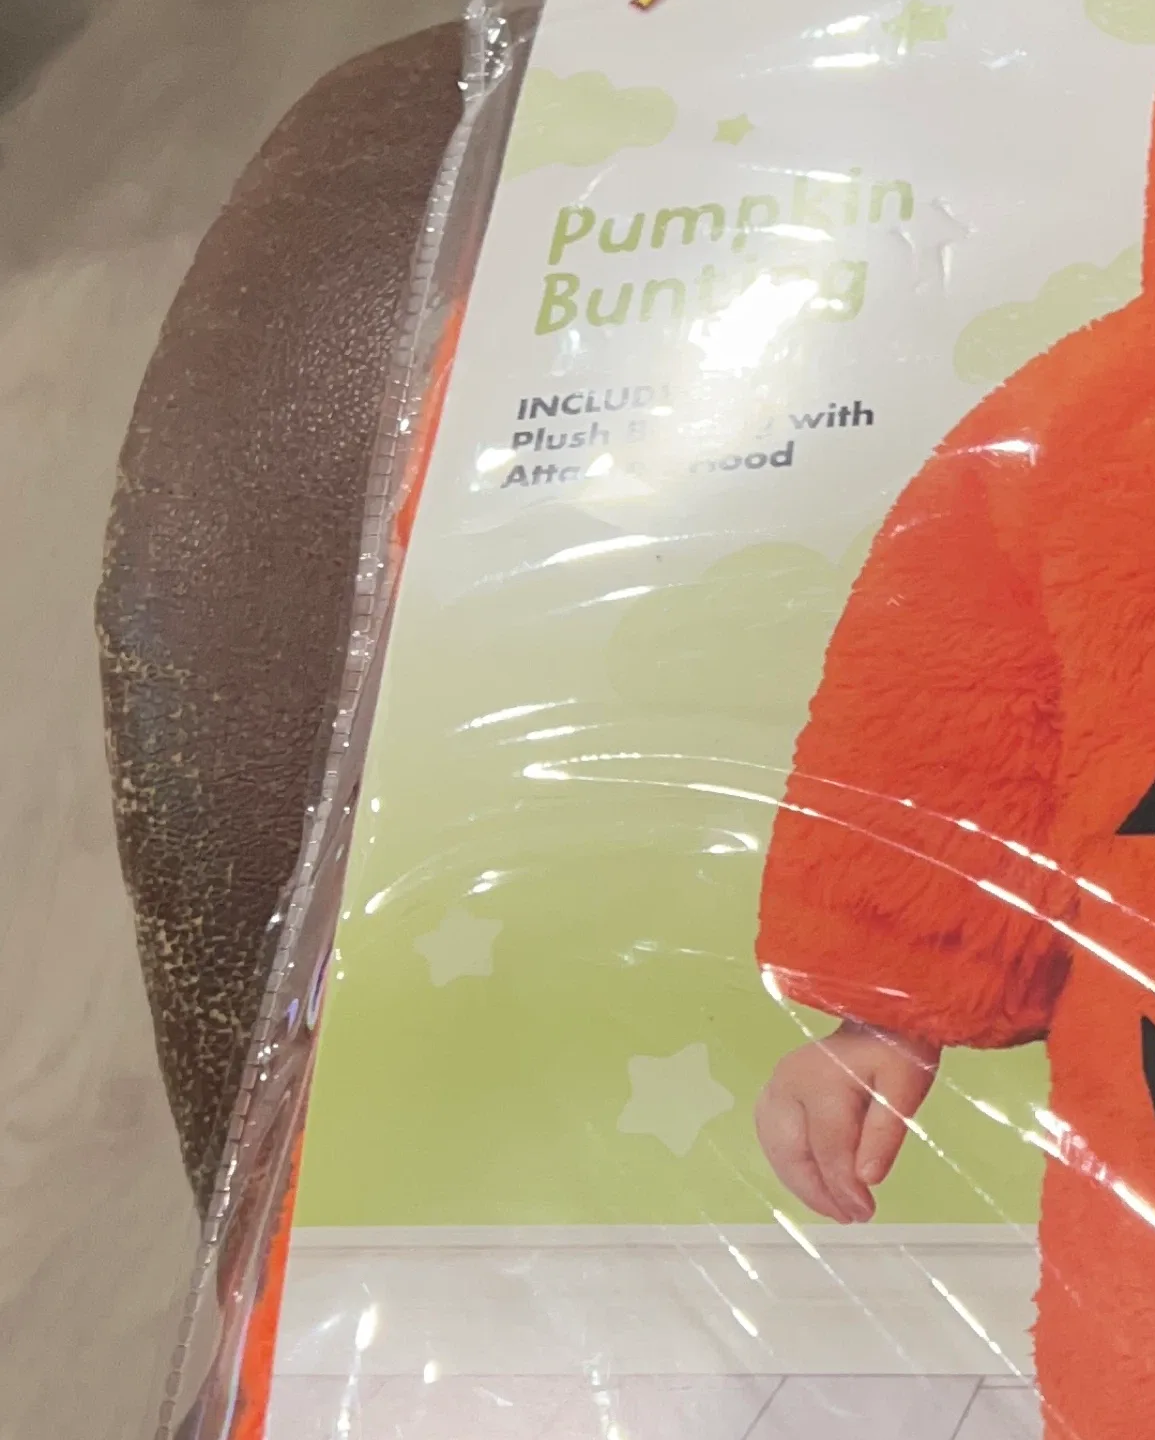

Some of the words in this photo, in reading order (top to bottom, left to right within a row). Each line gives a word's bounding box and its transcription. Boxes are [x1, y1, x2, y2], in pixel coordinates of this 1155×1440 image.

[548, 166, 915, 266] Pumpkin
[512, 422, 609, 452] Plush
[789, 400, 874, 430] with
